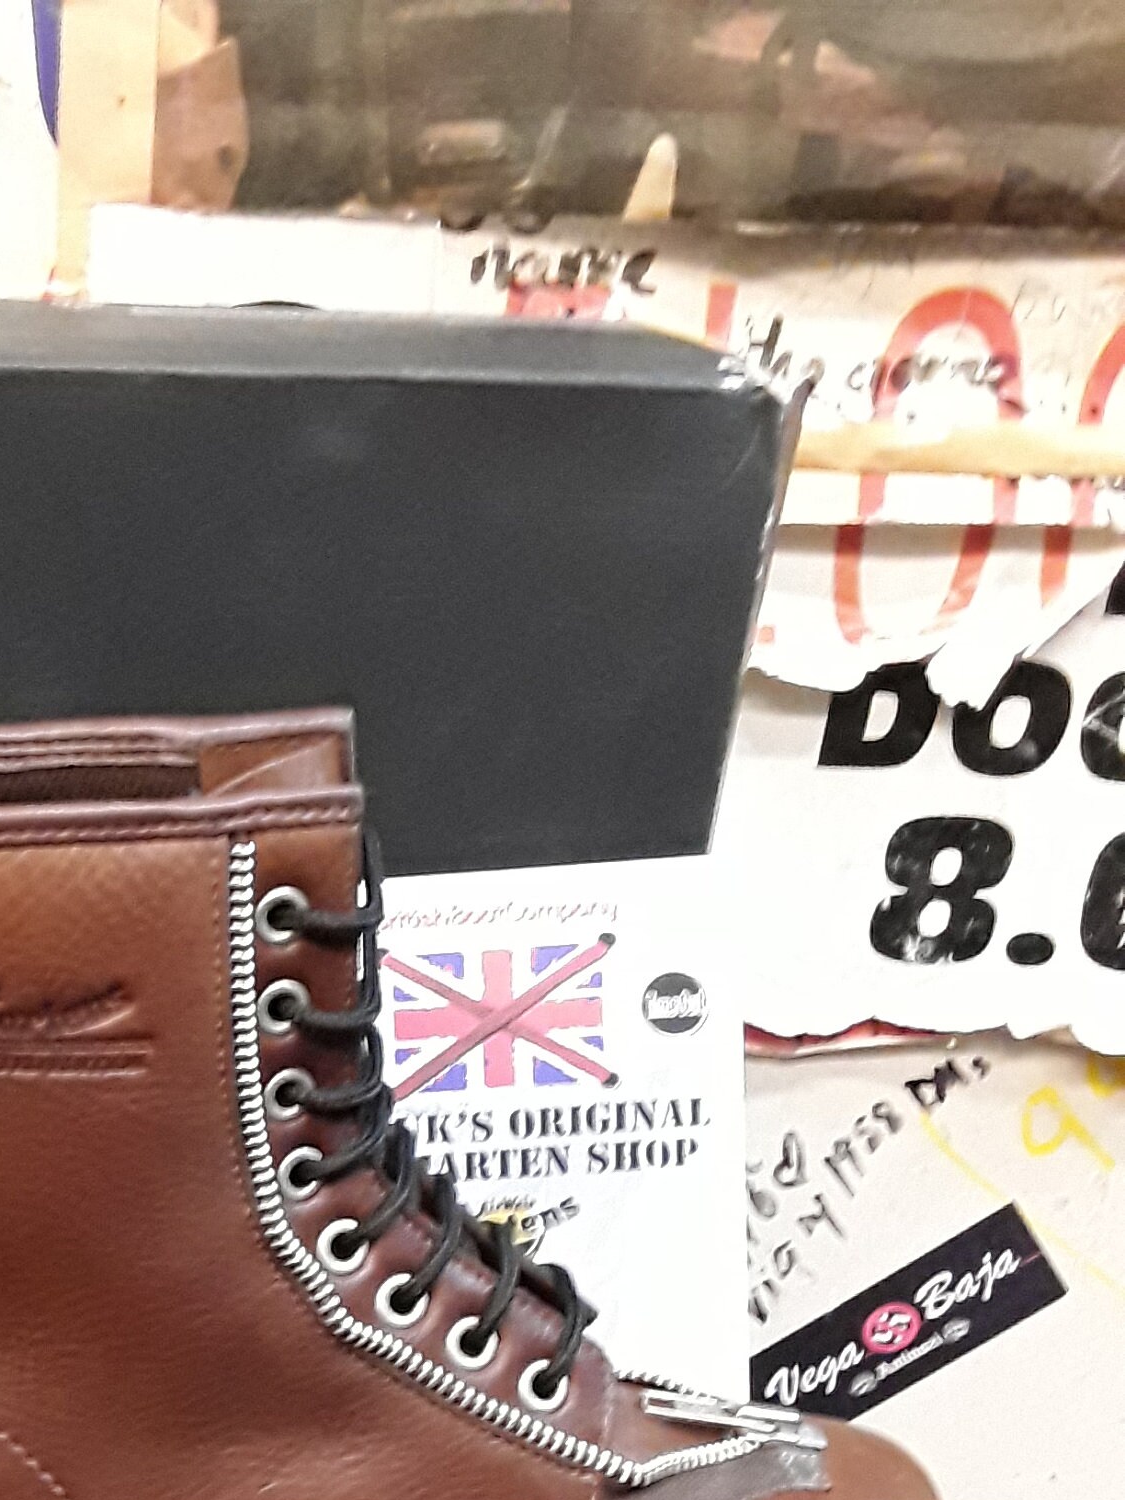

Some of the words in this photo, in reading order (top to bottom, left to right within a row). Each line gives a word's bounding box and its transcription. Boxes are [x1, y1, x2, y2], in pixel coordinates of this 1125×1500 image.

[509, 1097, 711, 1141] ORIGINAL
[587, 1138, 700, 1175] SHOP
[764, 1341, 865, 1406] Vega
[914, 1248, 1022, 1320] Baja
